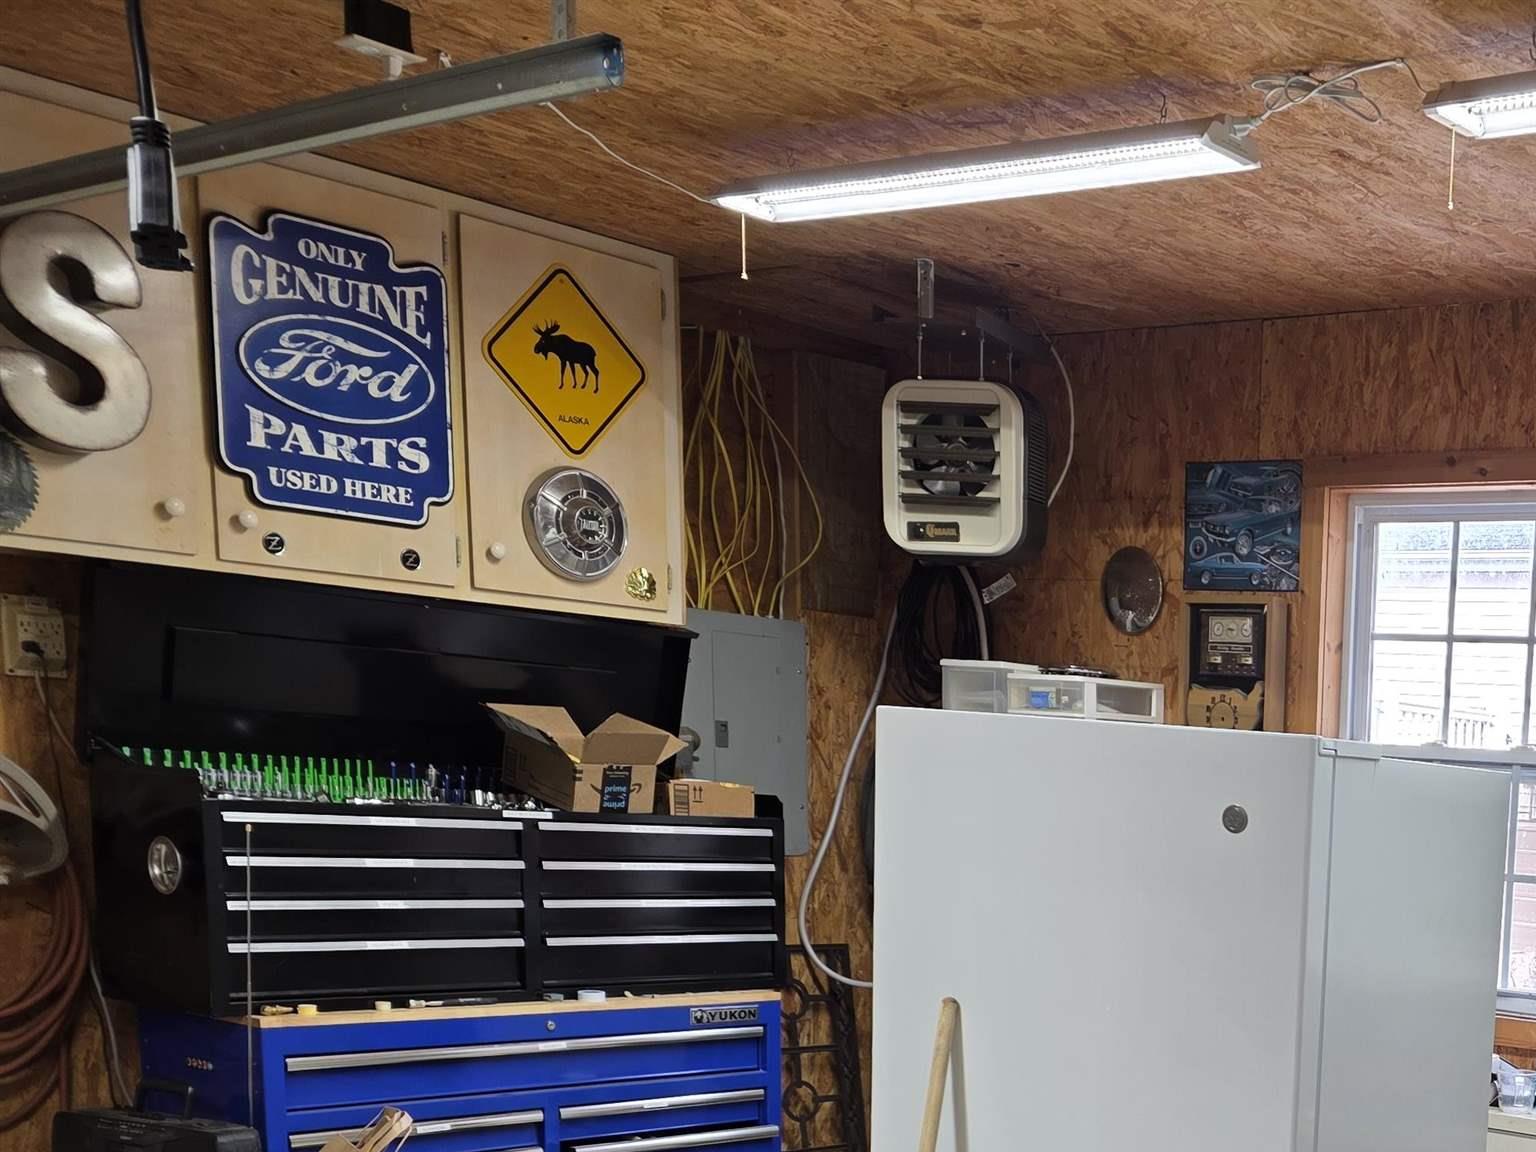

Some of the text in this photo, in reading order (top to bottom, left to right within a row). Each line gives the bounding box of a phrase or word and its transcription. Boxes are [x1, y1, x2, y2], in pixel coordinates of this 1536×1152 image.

[297, 238, 367, 271] ONLY
[231, 244, 432, 350] GENUINE
[254, 329, 420, 402] Ford
[558, 415, 590, 426] ALASKA
[244, 404, 430, 474] PARTS
[267, 466, 414, 507] USED HERE
[602, 800, 625, 809] prime
[604, 784, 627, 793] prime
[709, 1009, 757, 1021] YUKON
